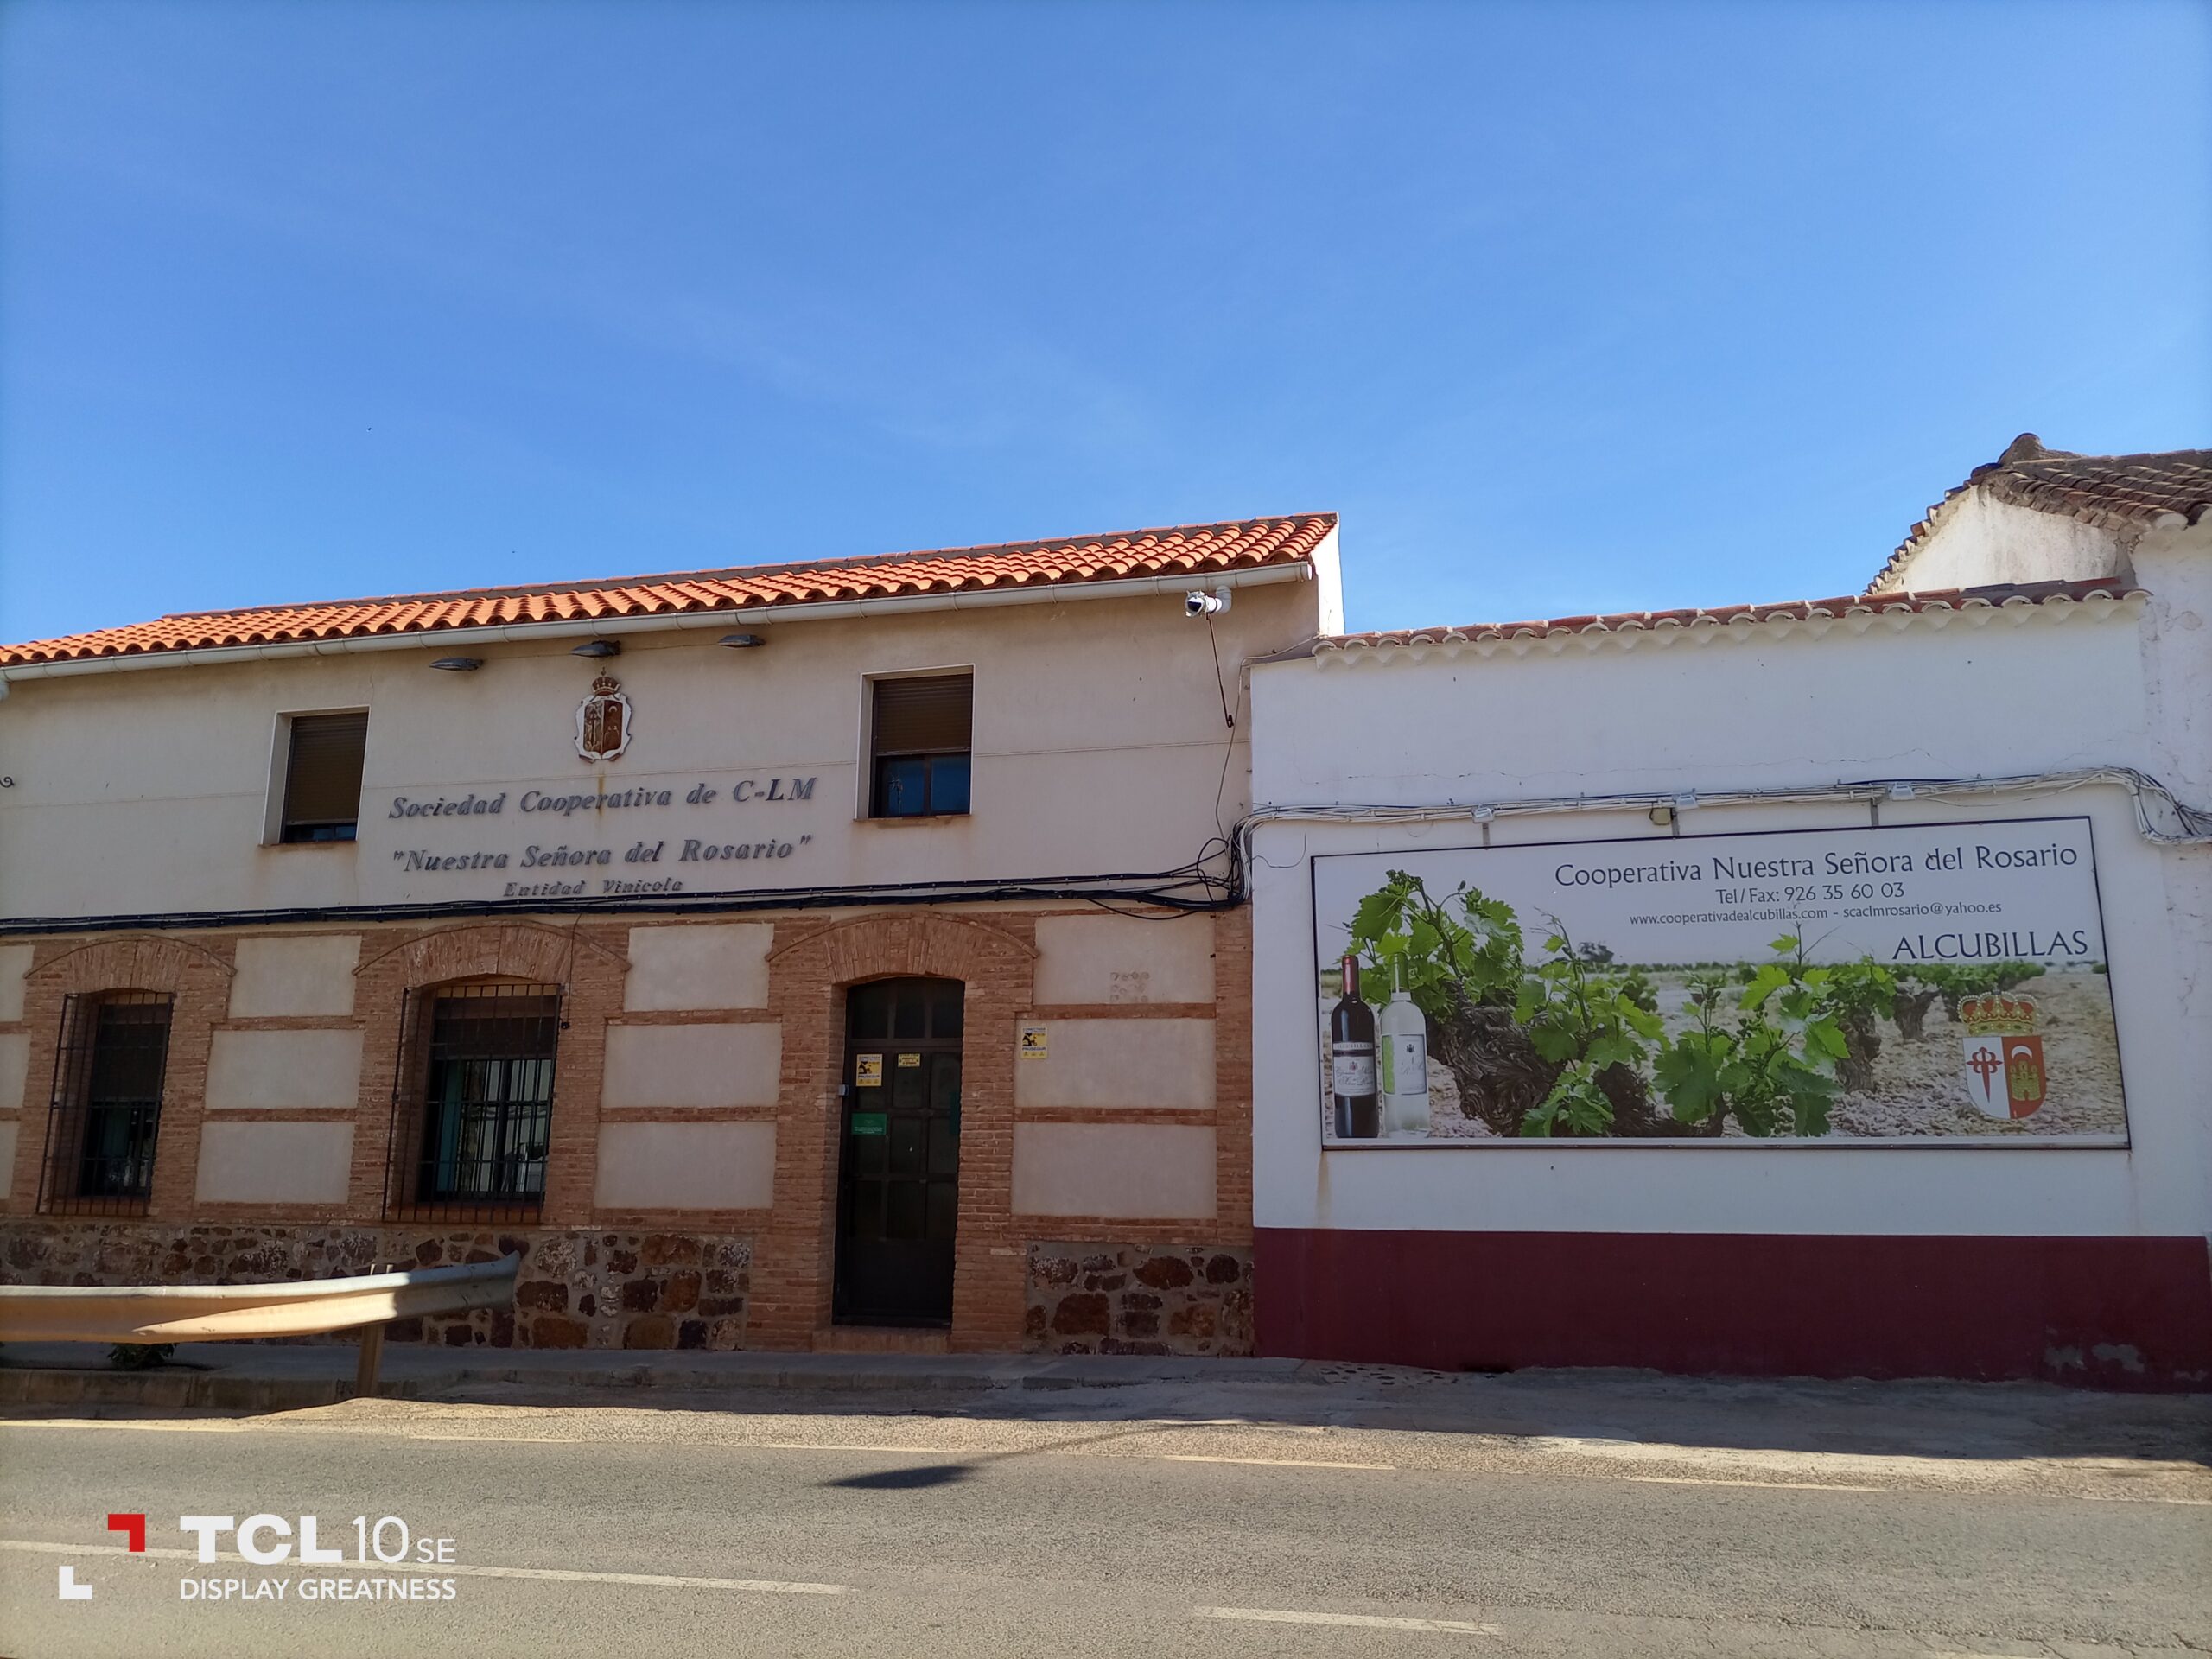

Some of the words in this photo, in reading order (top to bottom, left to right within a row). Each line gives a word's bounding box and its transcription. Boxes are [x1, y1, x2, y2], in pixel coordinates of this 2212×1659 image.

[389, 792, 506, 819] Sociedad
[520, 787, 671, 817] Cooperativa
[686, 783, 717, 804] de
[733, 777, 817, 802] C-LM
[520, 845, 612, 868] Señora
[624, 841, 664, 863] del
[1555, 861, 1702, 888] Cooperativa
[1713, 856, 1815, 880] Nuestra
[1825, 851, 1913, 874] Señora
[1925, 847, 1963, 870] del
[1975, 843, 2078, 868] Rosario
[503, 880, 586, 897] Entidad
[1784, 886, 1816, 901] 926
[1822, 884, 1844, 899] 35
[1850, 883, 1874, 899] 60
[1881, 882, 1904, 898] 03
[1630, 908, 1828, 925] www.cooperativadealcubillas.com
[1843, 902, 2002, 918] scaclmrosario@yahoo.es
[1891, 931, 2088, 959] ALCUBILLAS
